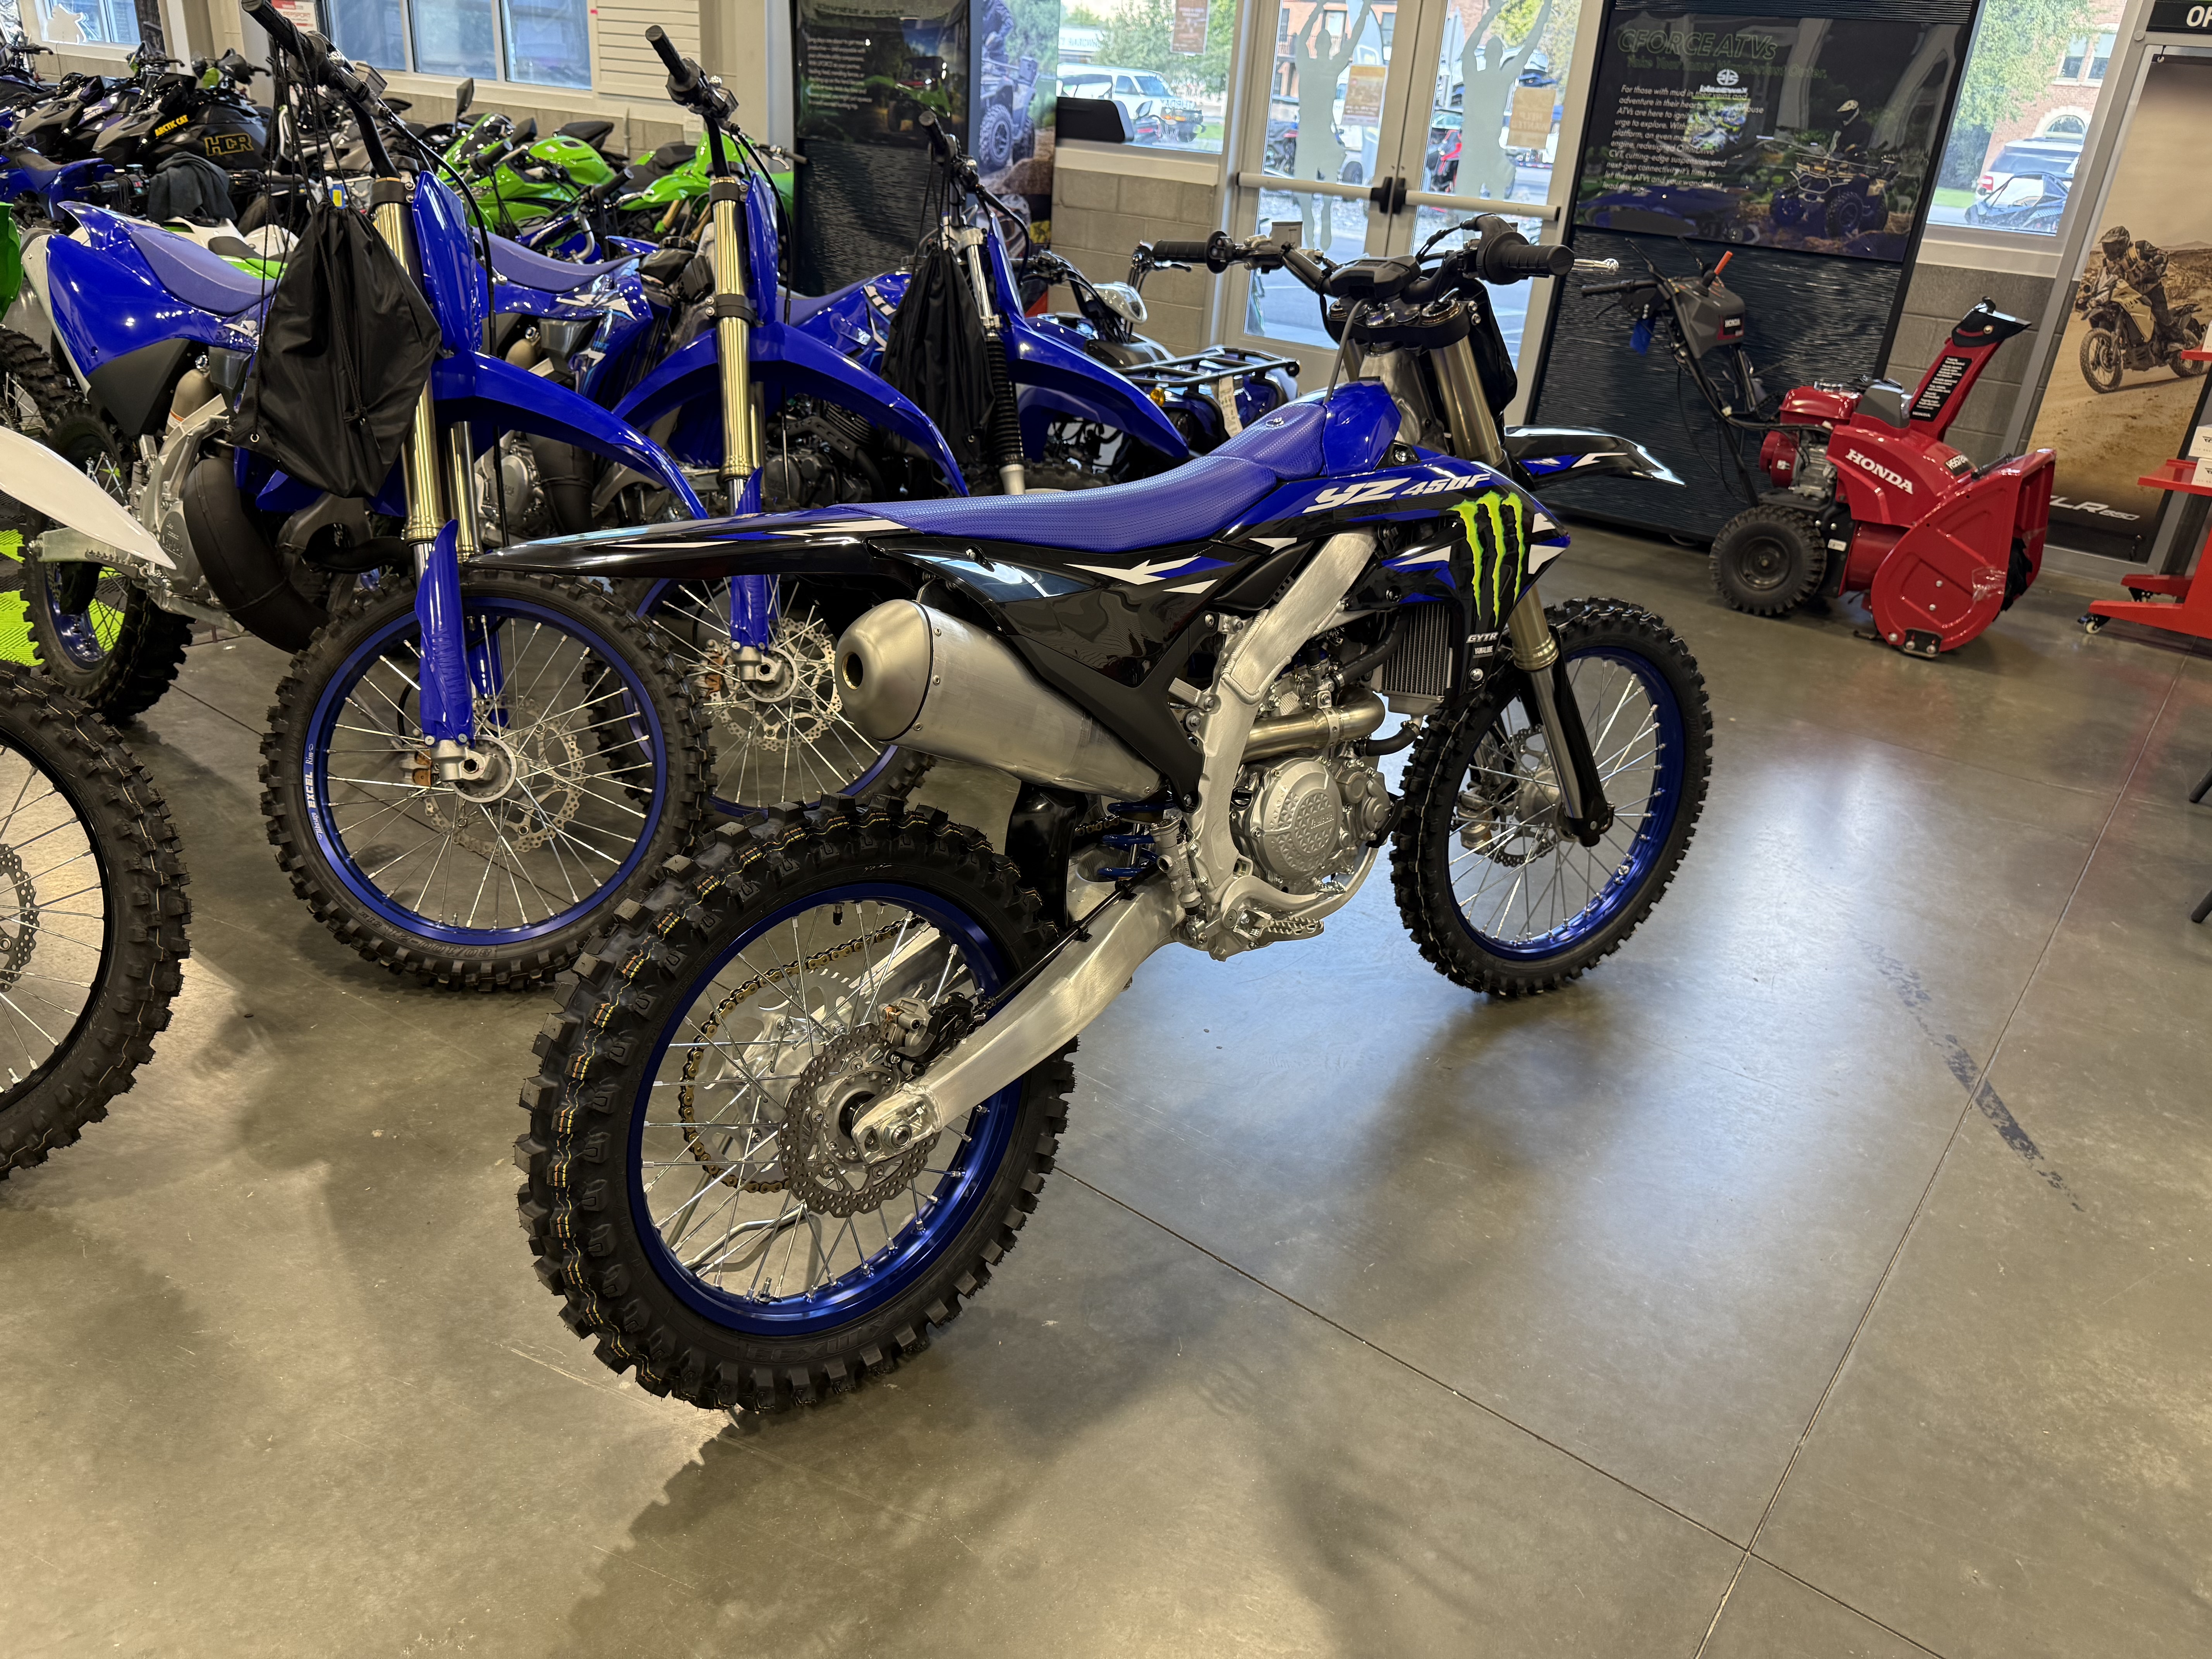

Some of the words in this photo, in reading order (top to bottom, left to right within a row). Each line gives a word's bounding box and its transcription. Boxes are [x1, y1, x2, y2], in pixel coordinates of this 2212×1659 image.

[1618, 29, 1716, 57] CFORCE
[1713, 33, 1778, 60] ATVs
[1621, 84, 1633, 93] For
[1633, 85, 1653, 94] those
[1654, 87, 1669, 95] with
[1669, 89, 1686, 97] mud
[1619, 96, 1654, 106] adventure
[1663, 99, 1680, 107] their
[1616, 106, 1633, 115] ATVs
[1647, 108, 1664, 117] here
[155, 119, 177, 137] ARCTIC
[175, 114, 189, 127] CAT
[1614, 119, 1632, 128] urge
[1632, 119, 1640, 127] to
[1637, 141, 1676, 153] redesigned
[1711, 159, 1728, 167] and
[1651, 175, 1666, 184] and
[1724, 318, 1741, 328] HONDA
[1845, 448, 1913, 495] HONDA
[1302, 477, 1412, 514] YZ
[1400, 473, 1491, 496] 450F
[1466, 631, 1499, 644] GYTR
[1474, 645, 1494, 654] YAMALUBE
[429, 628, 468, 701] YAMAHA
[305, 744, 314, 766] Rim
[305, 772, 316, 809] EXCEL
[1310, 811, 1334, 829] YAMAHA
